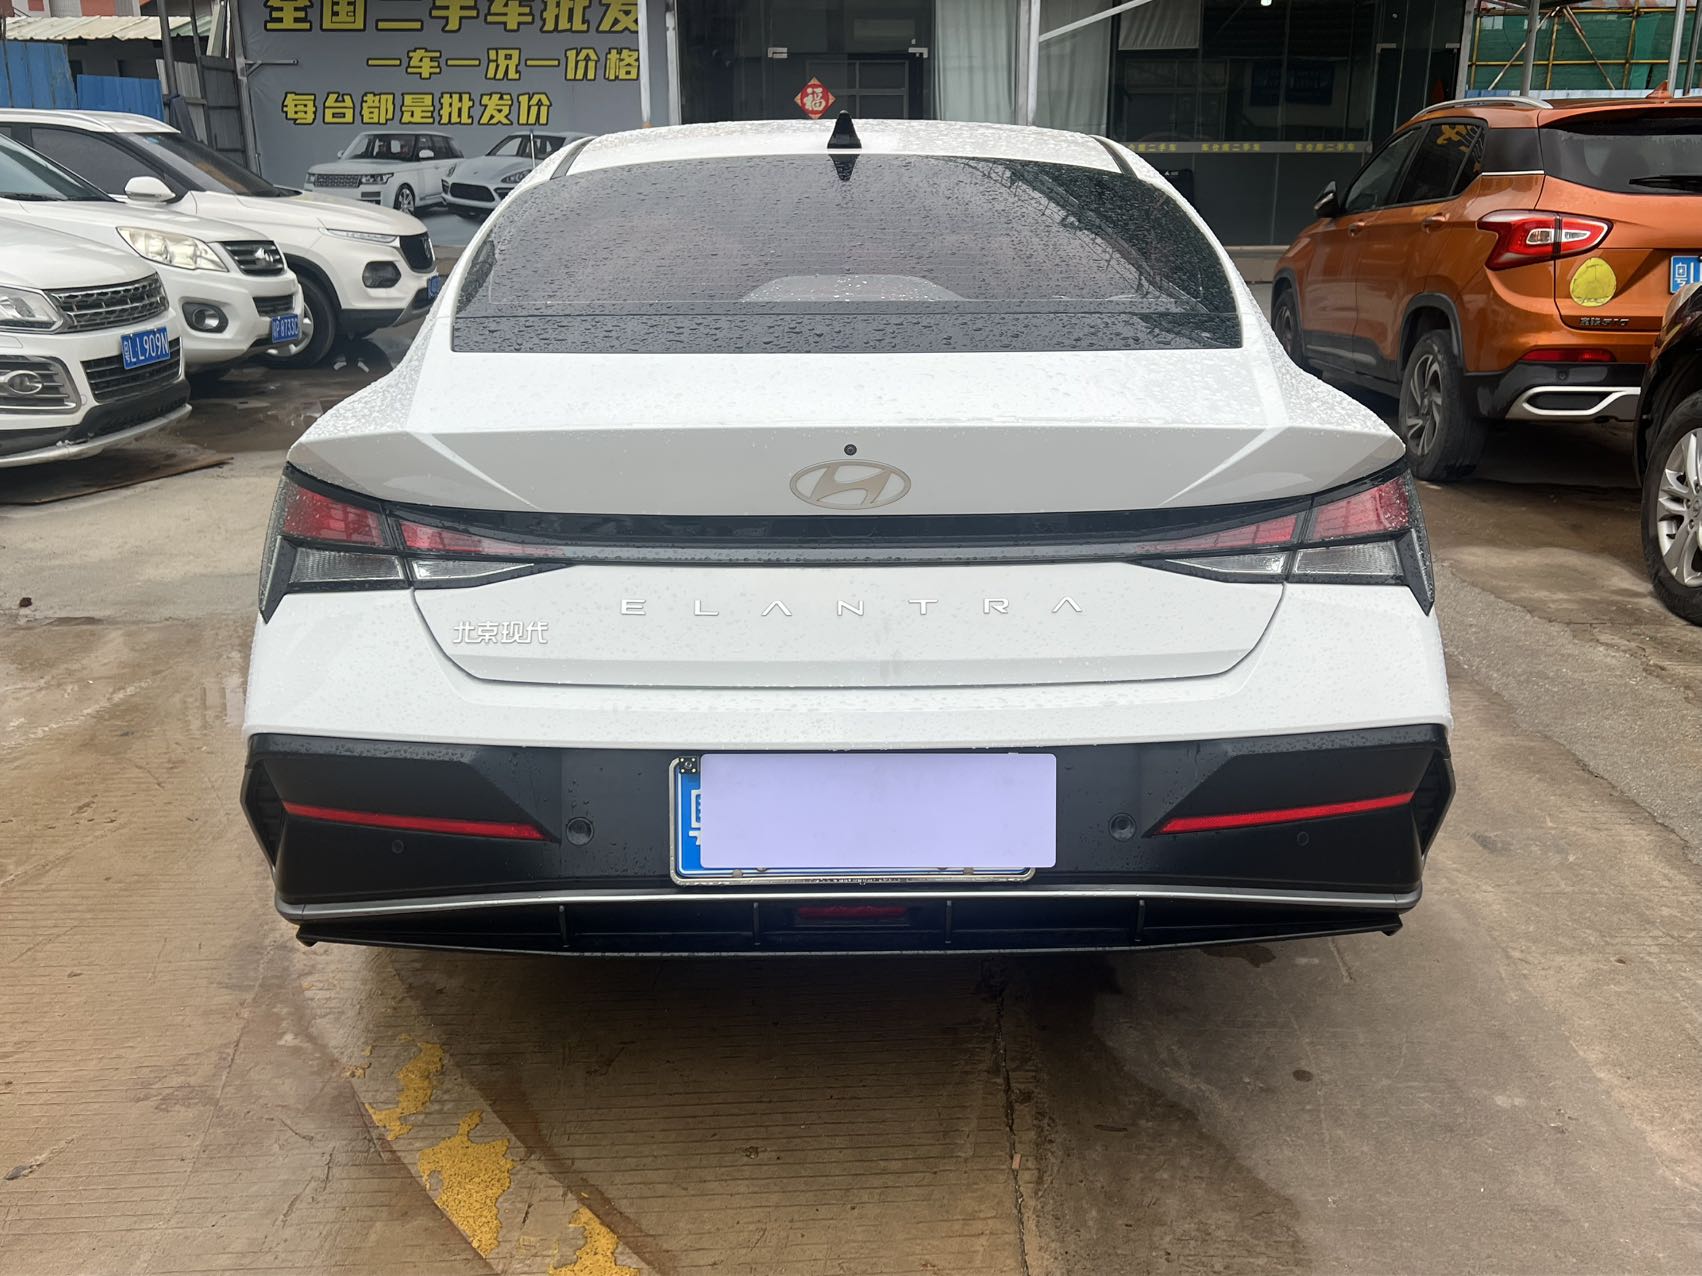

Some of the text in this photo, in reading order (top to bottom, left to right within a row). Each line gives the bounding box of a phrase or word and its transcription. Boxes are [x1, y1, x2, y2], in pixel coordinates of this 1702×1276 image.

[367, 48, 639, 81] 一车一况一价格
[282, 92, 552, 125] 每台都是批发价
[804, 87, 826, 111] 福
[620, 597, 1083, 616] ELANTRA
[452, 620, 549, 645] 北京现代
